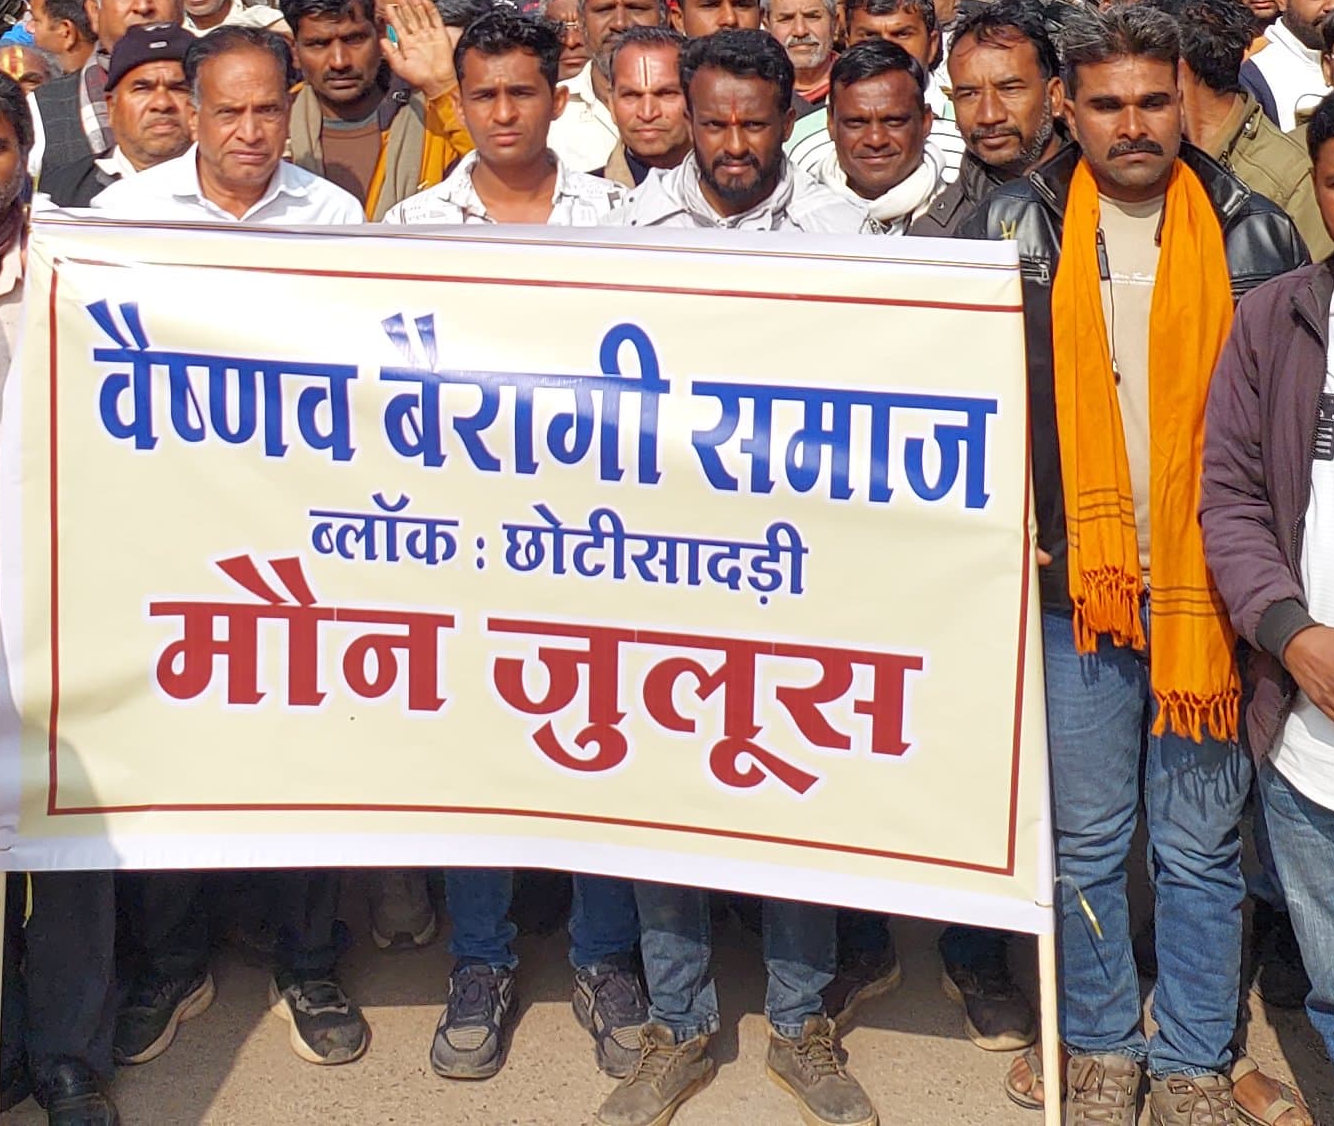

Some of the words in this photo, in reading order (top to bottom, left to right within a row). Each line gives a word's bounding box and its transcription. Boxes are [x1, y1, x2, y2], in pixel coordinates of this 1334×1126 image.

[85, 300, 358, 462] वैष्णव
[379, 312, 670, 485] बैरागी
[691, 381, 998, 510] समाज
[310, 493, 459, 567] ब्लॉक
[502, 504, 809, 605] छोटीसादड़ी
[150, 555, 455, 711] मौन
[487, 618, 923, 794] जुलूस
